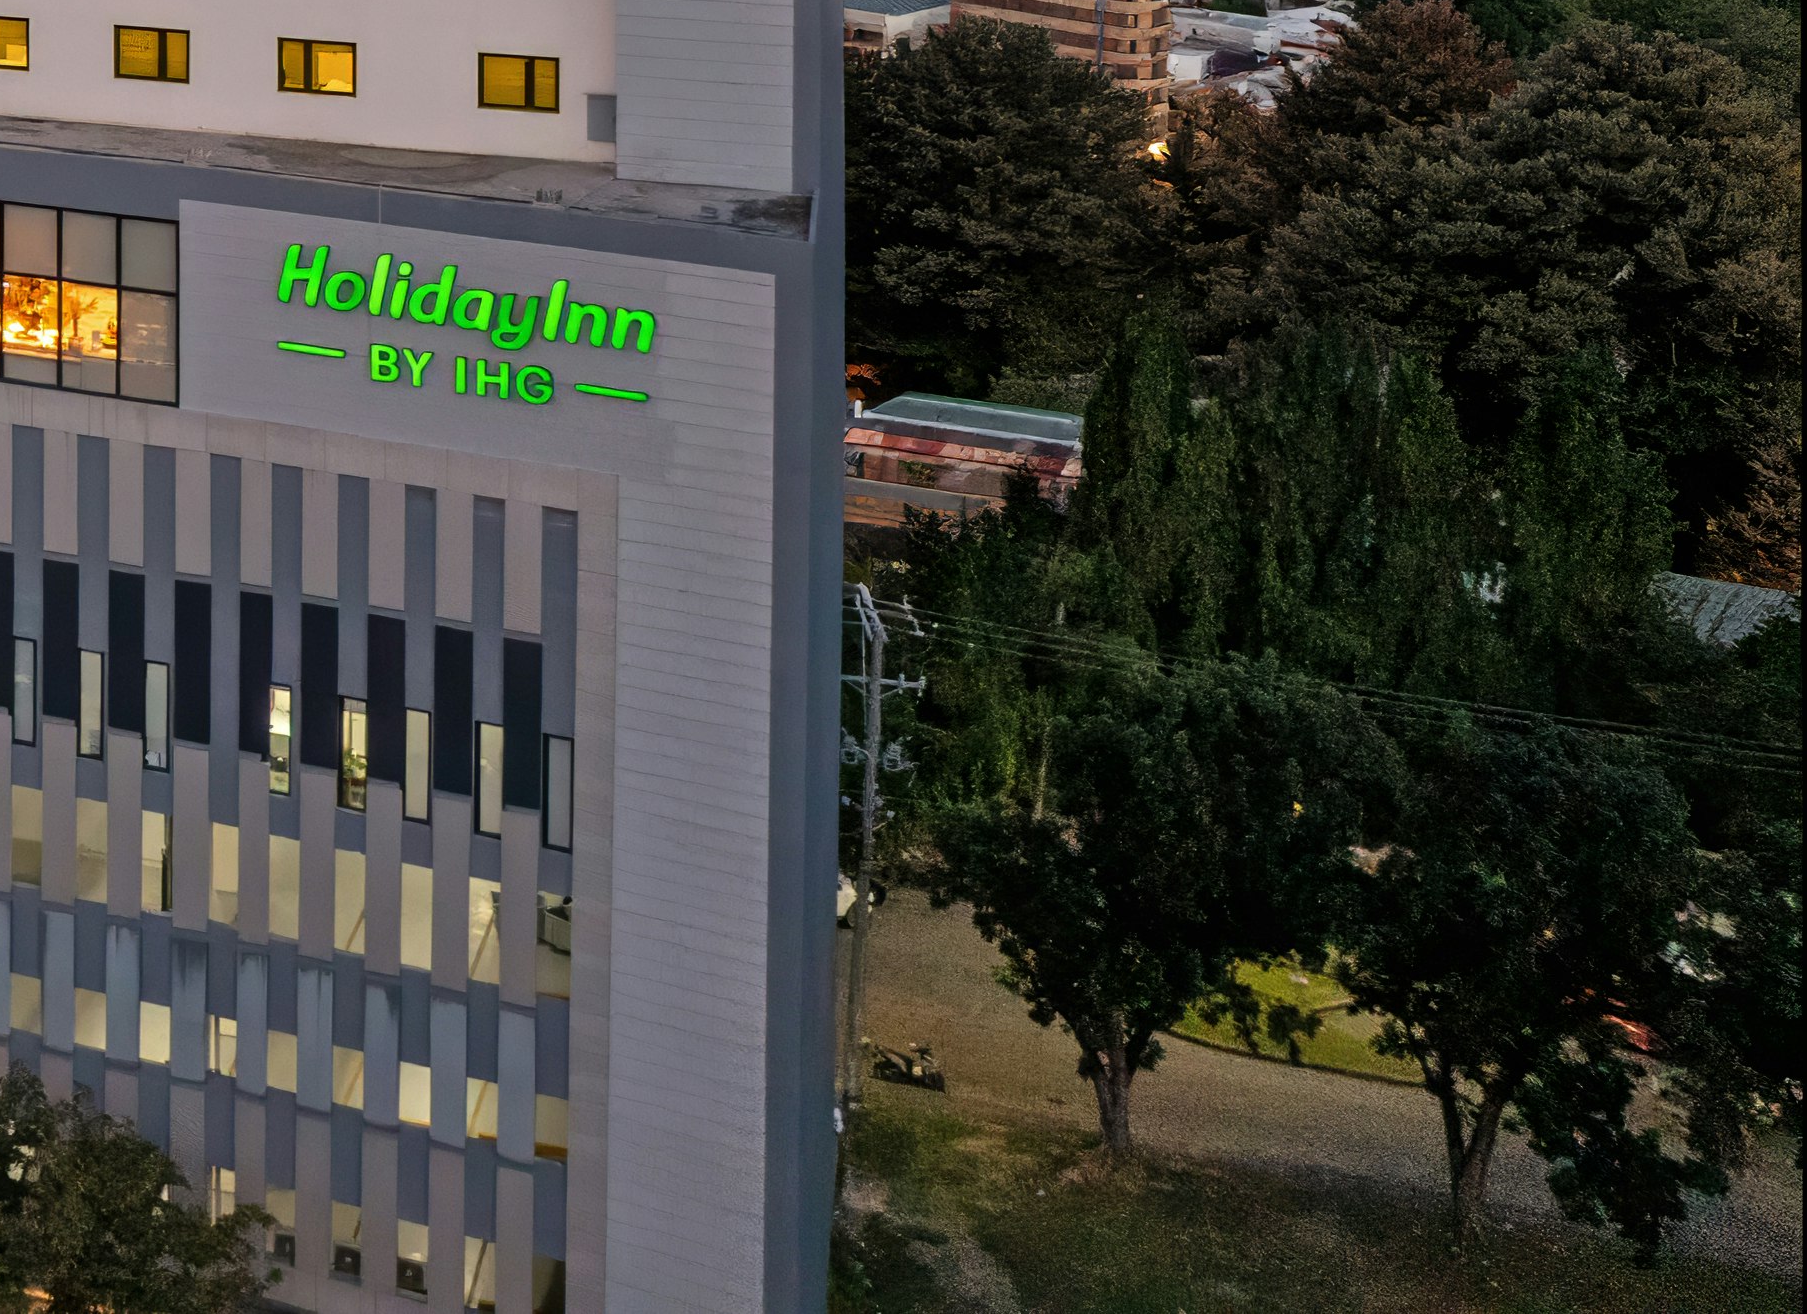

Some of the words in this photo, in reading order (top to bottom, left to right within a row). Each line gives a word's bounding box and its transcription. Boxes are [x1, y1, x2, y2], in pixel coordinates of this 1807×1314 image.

[276, 243, 540, 352] Holiday
[541, 279, 656, 355] Inn
[369, 343, 434, 389] BY
[454, 356, 555, 406] IHG
